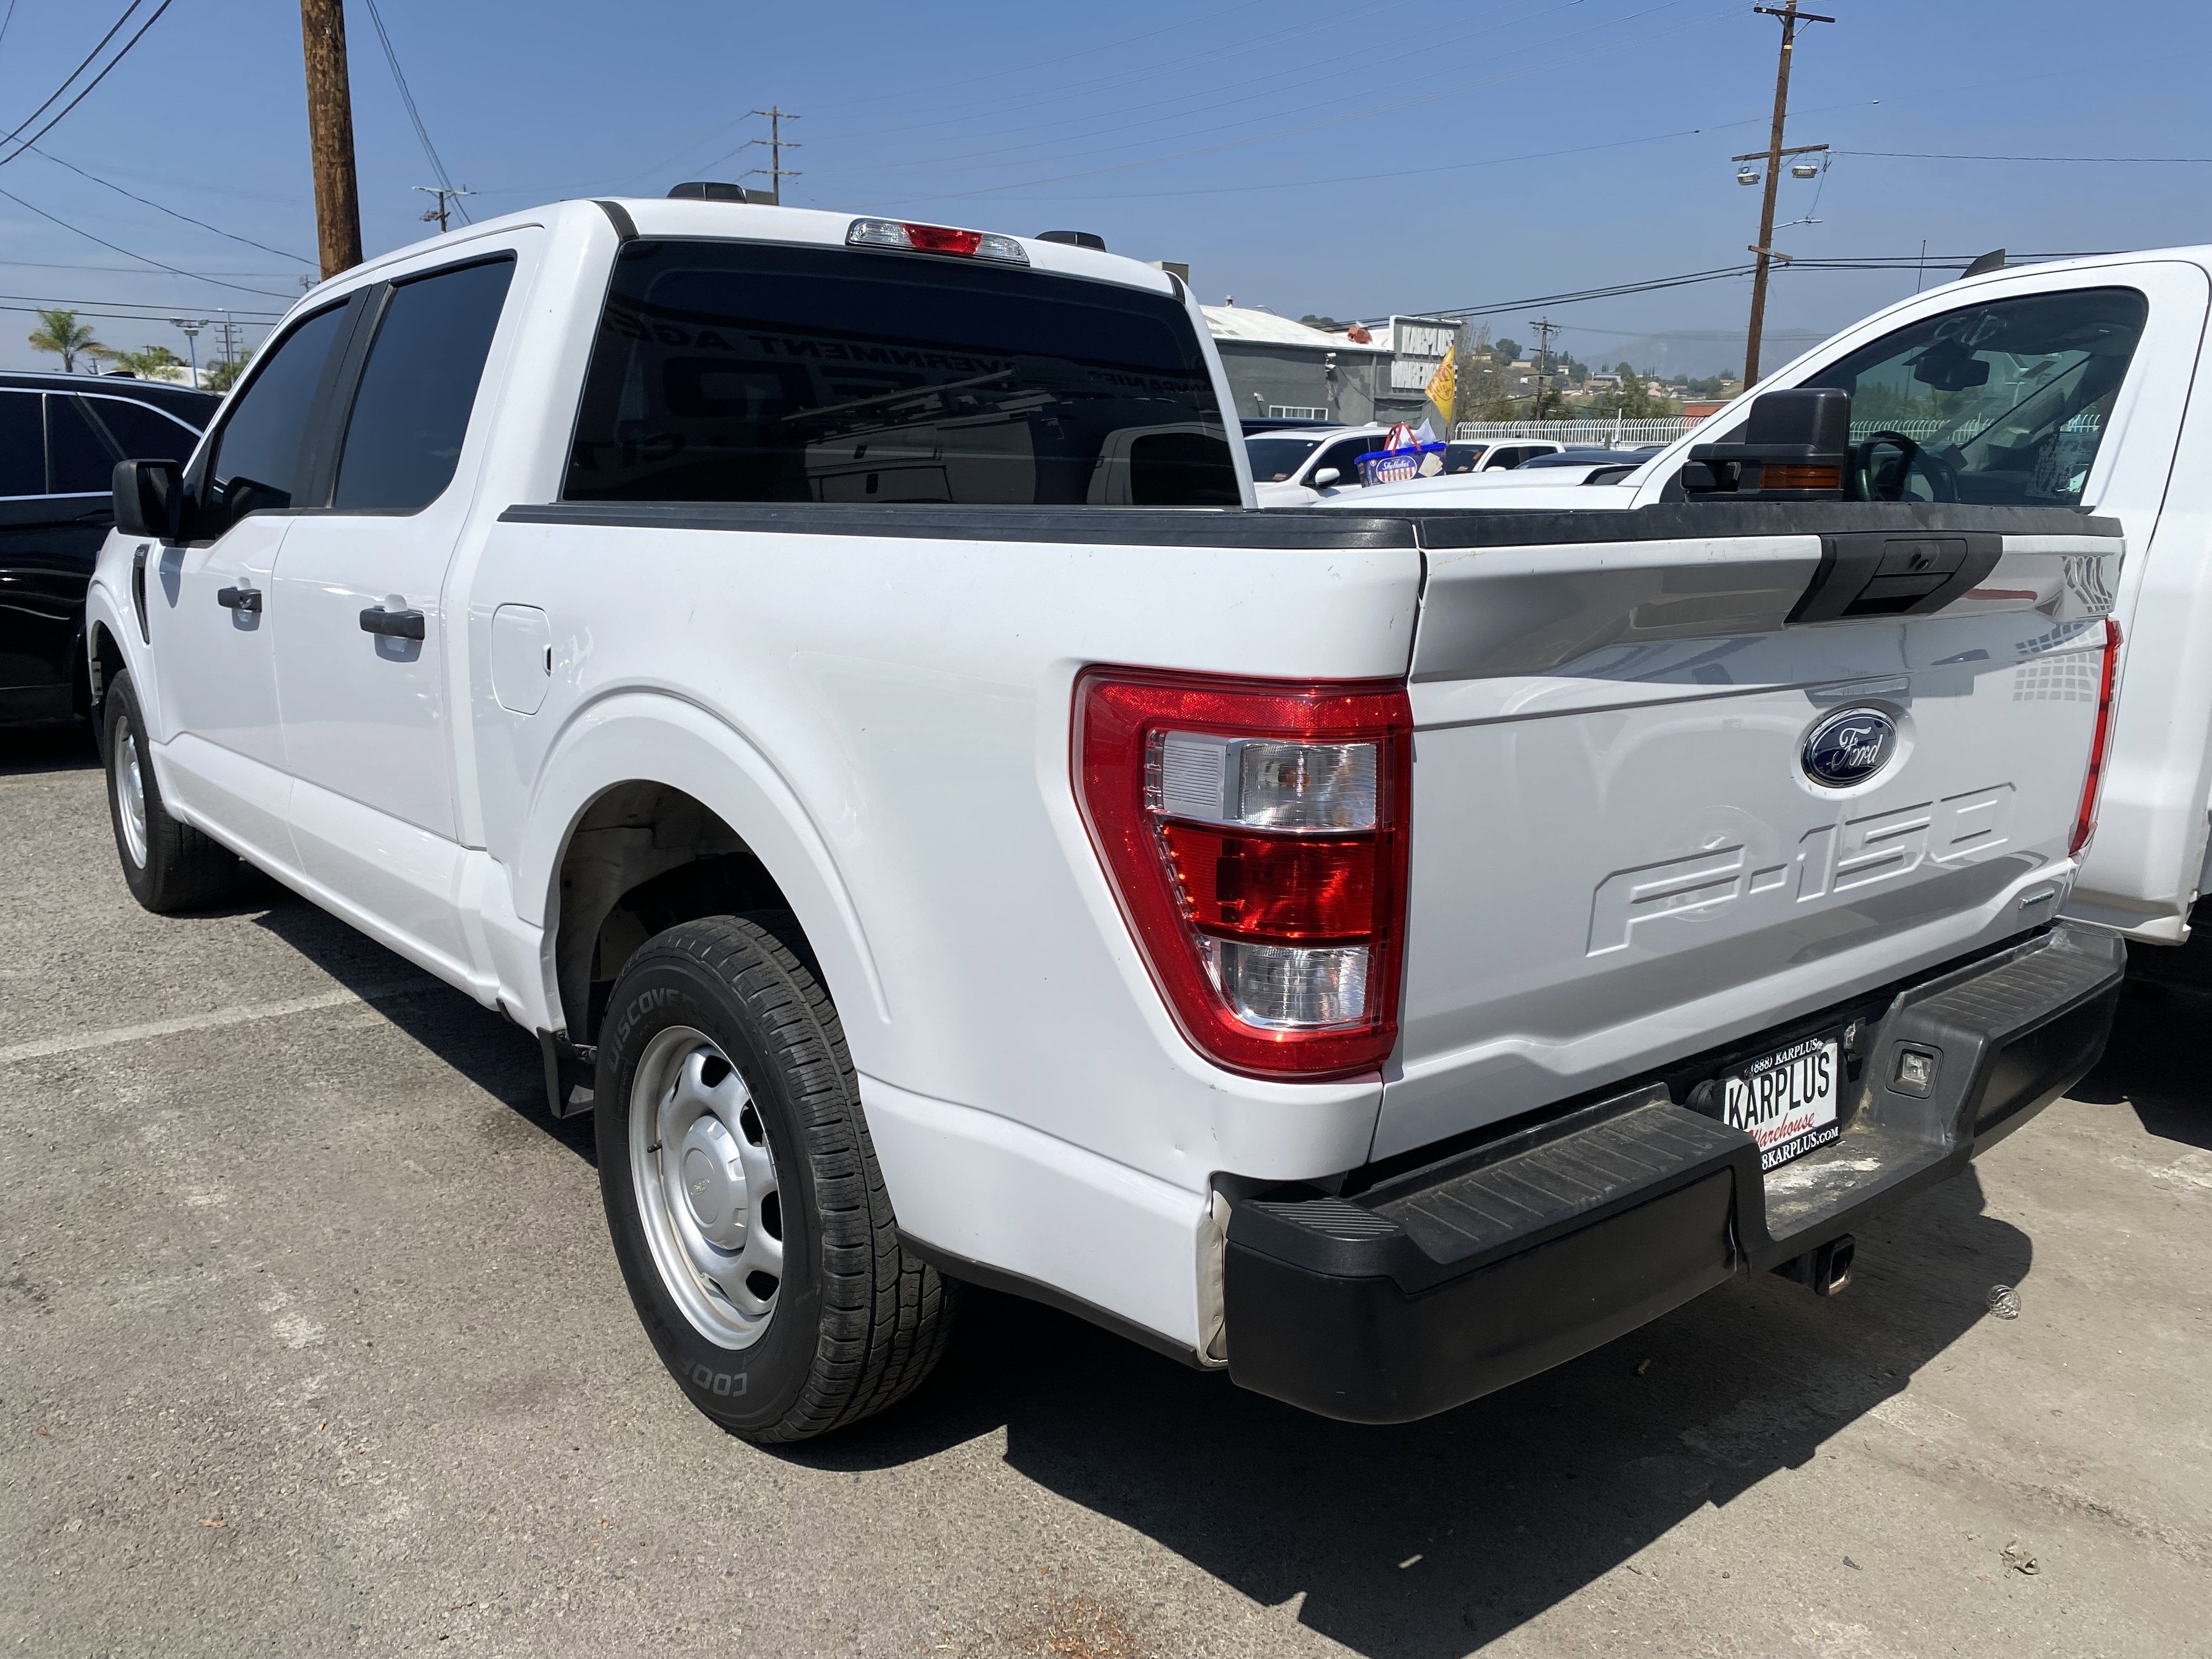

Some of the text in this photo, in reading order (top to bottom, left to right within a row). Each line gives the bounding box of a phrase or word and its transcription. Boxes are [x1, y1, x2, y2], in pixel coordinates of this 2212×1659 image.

[1832, 726, 1883, 772] Ford
[1586, 782, 2017, 958] F-150
[1751, 1038, 1818, 1074] (888) KARPLUS
[1729, 1051, 1830, 1130] KARPLUS
